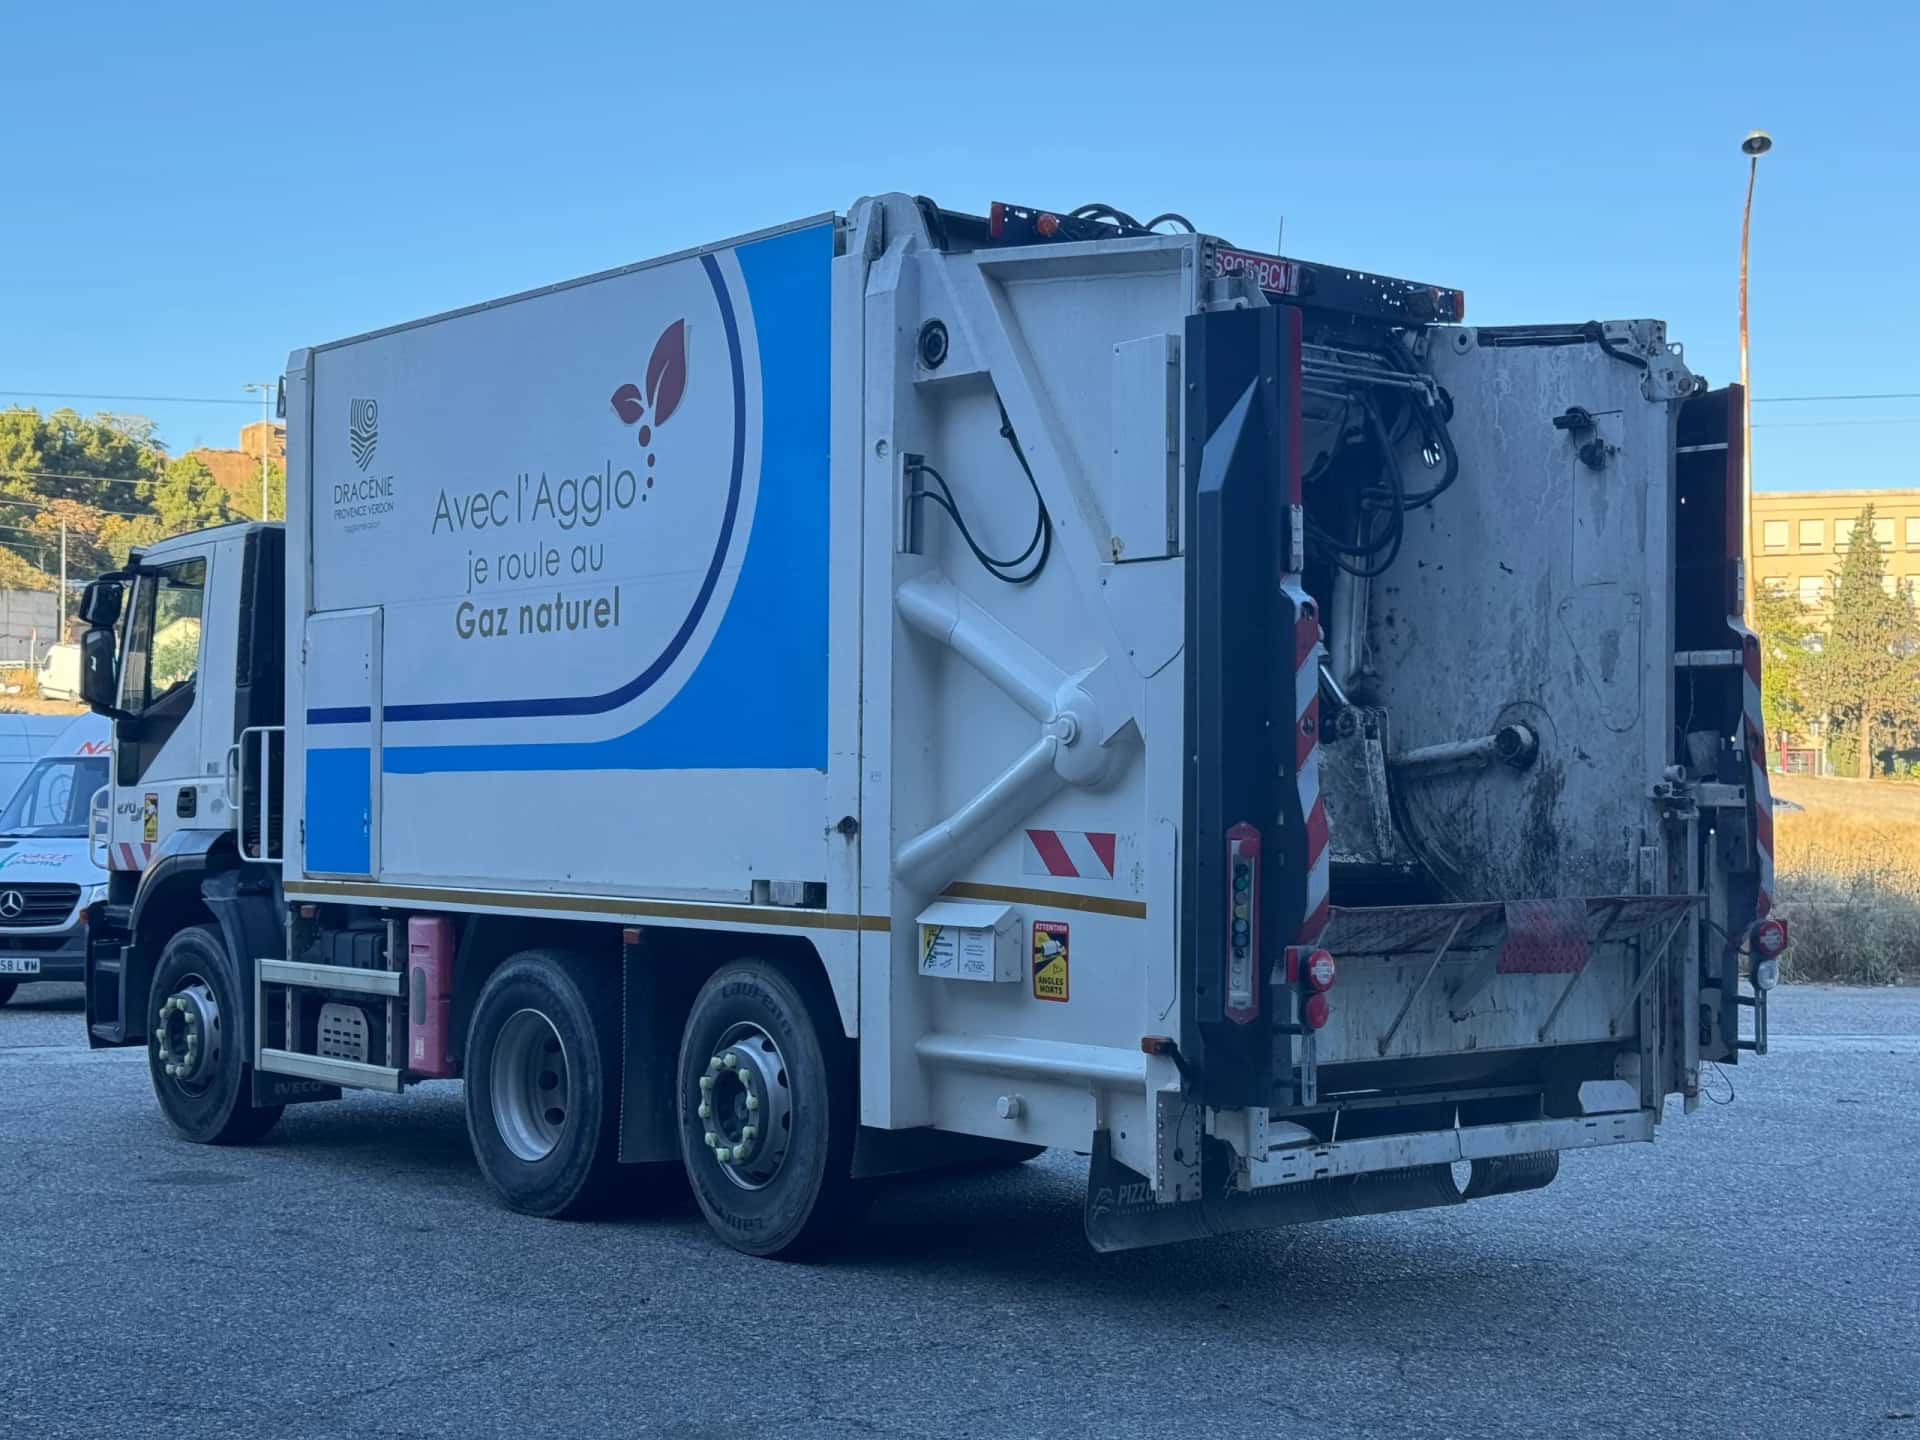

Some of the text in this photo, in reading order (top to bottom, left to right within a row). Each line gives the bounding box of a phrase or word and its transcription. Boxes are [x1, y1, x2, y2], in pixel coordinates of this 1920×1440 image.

[432, 459, 637, 535] Avec l'Agglo
[466, 541, 604, 594] je roule au
[456, 585, 620, 639] Gaz naturel
[1035, 922, 1067, 933] ATTENTION
[1038, 975, 1064, 986] ANGLES
[1039, 984, 1063, 995] MORTS
